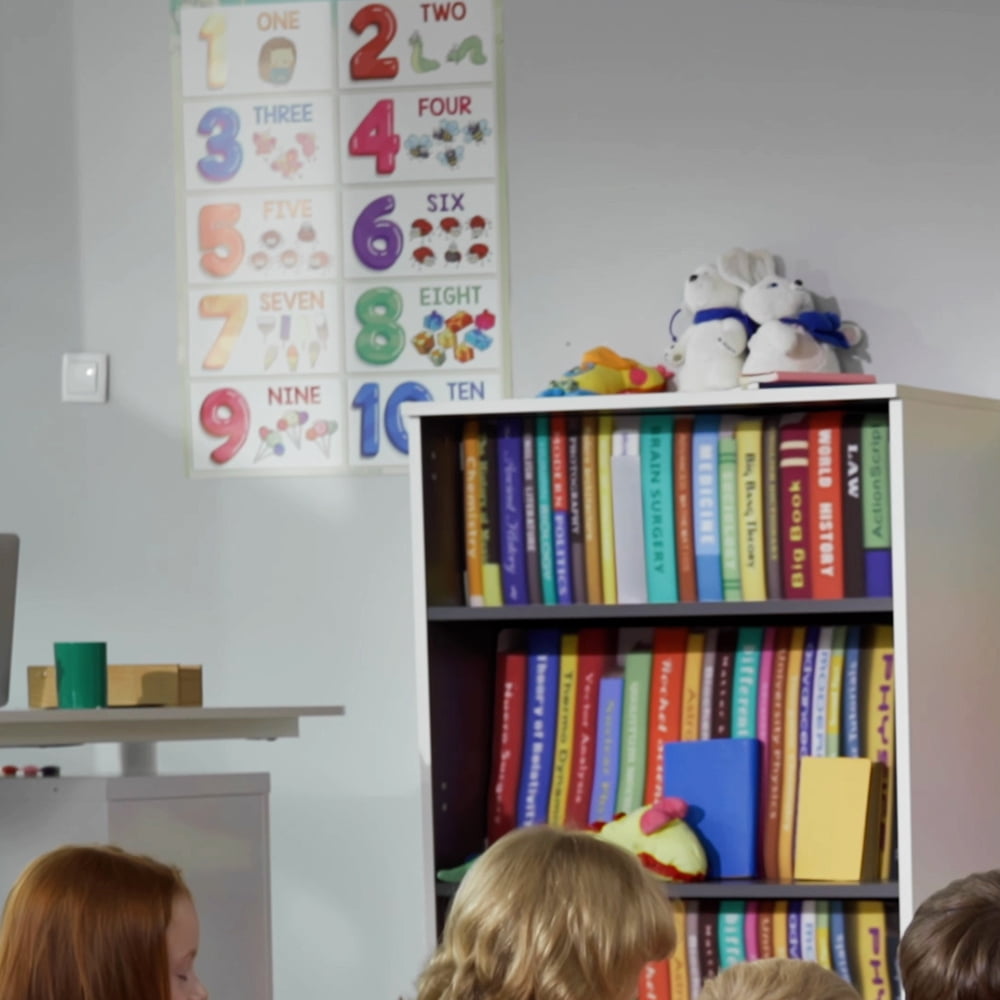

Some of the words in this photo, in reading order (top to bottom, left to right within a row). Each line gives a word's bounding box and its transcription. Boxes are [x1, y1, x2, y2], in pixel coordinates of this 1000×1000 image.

[257, 11, 300, 31] ONE
[349, 3, 399, 81] 2
[420, 2, 467, 22] TWO
[200, 13, 227, 89] 1
[253, 104, 313, 125] THREE
[349, 99, 400, 175] 4
[417, 96, 472, 117] FOUR
[197, 106, 243, 182] 3
[262, 199, 313, 219] FIVE
[352, 194, 404, 271] 6
[426, 193, 465, 213] SIX
[198, 203, 245, 277] 5
[259, 291, 325, 312] SEVEN
[355, 286, 406, 366] 8
[420, 286, 482, 306] EIGHT
[198, 293, 249, 370] 7
[267, 386, 322, 405] NINE
[447, 381, 486, 401] TEN
[200, 387, 251, 465] 9
[817, 429, 832, 489] WORLD
[847, 444, 859, 499] LAW
[699, 444, 716, 544] MEDICINE
[789, 480, 803, 542] Book
[650, 488, 665, 574] SURGERY
[818, 502, 835, 577] HISTORY
[790, 548, 806, 588] Big
